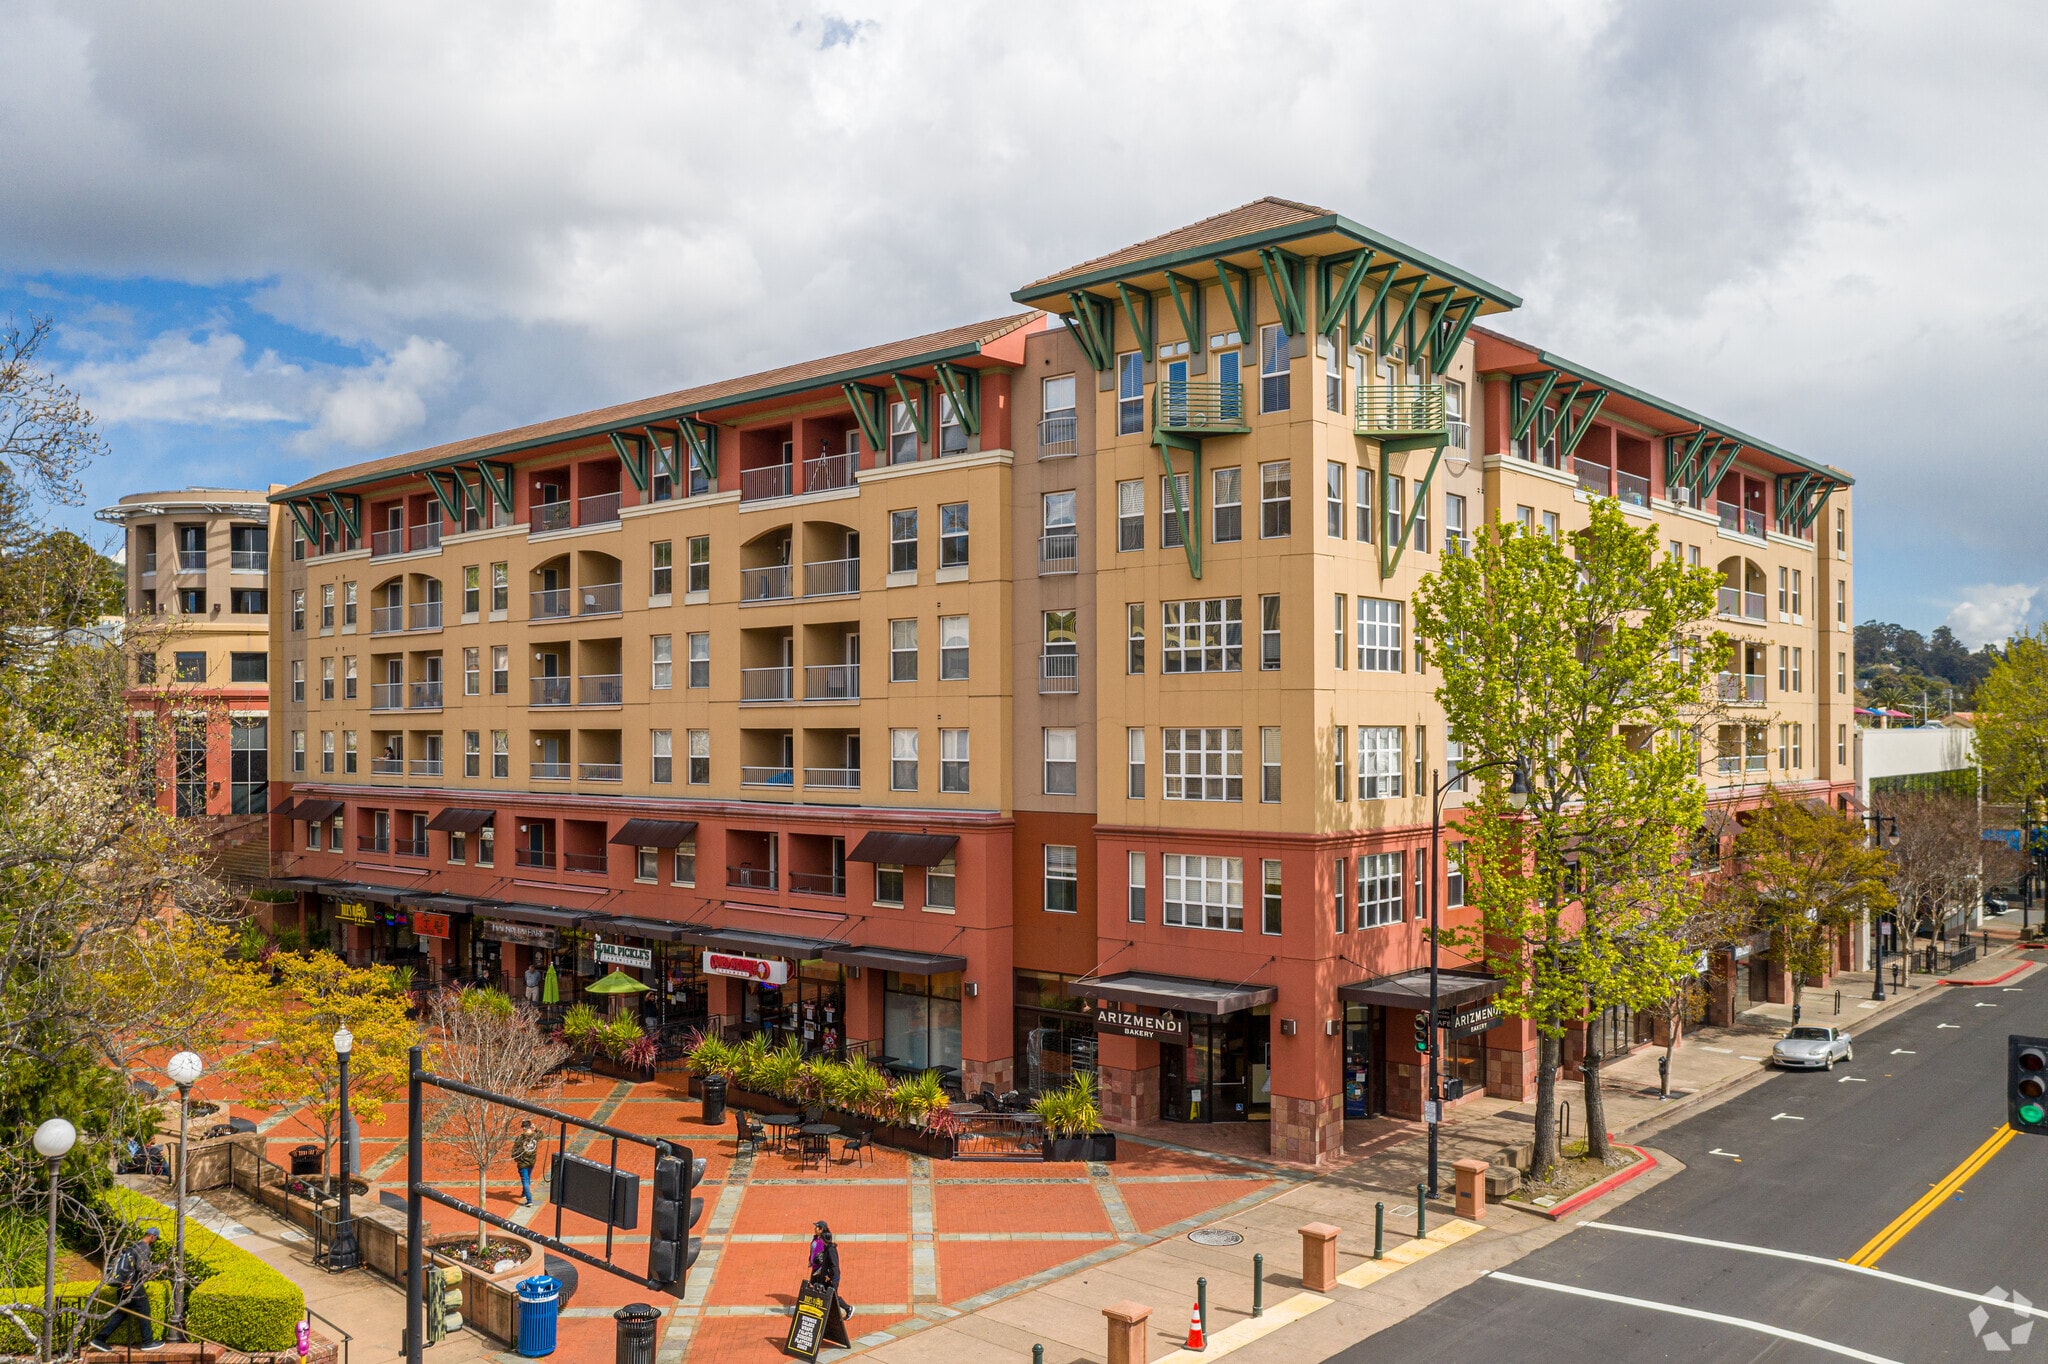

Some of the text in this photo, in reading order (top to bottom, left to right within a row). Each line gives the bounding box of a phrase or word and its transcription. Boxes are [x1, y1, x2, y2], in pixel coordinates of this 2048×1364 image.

[617, 946, 650, 960] PICKLE'S
[1097, 1011, 1182, 1032] ARIZMENDI
[1470, 1022, 1488, 1033] BAKERY
[1124, 1028, 1154, 1038] BAKERY
